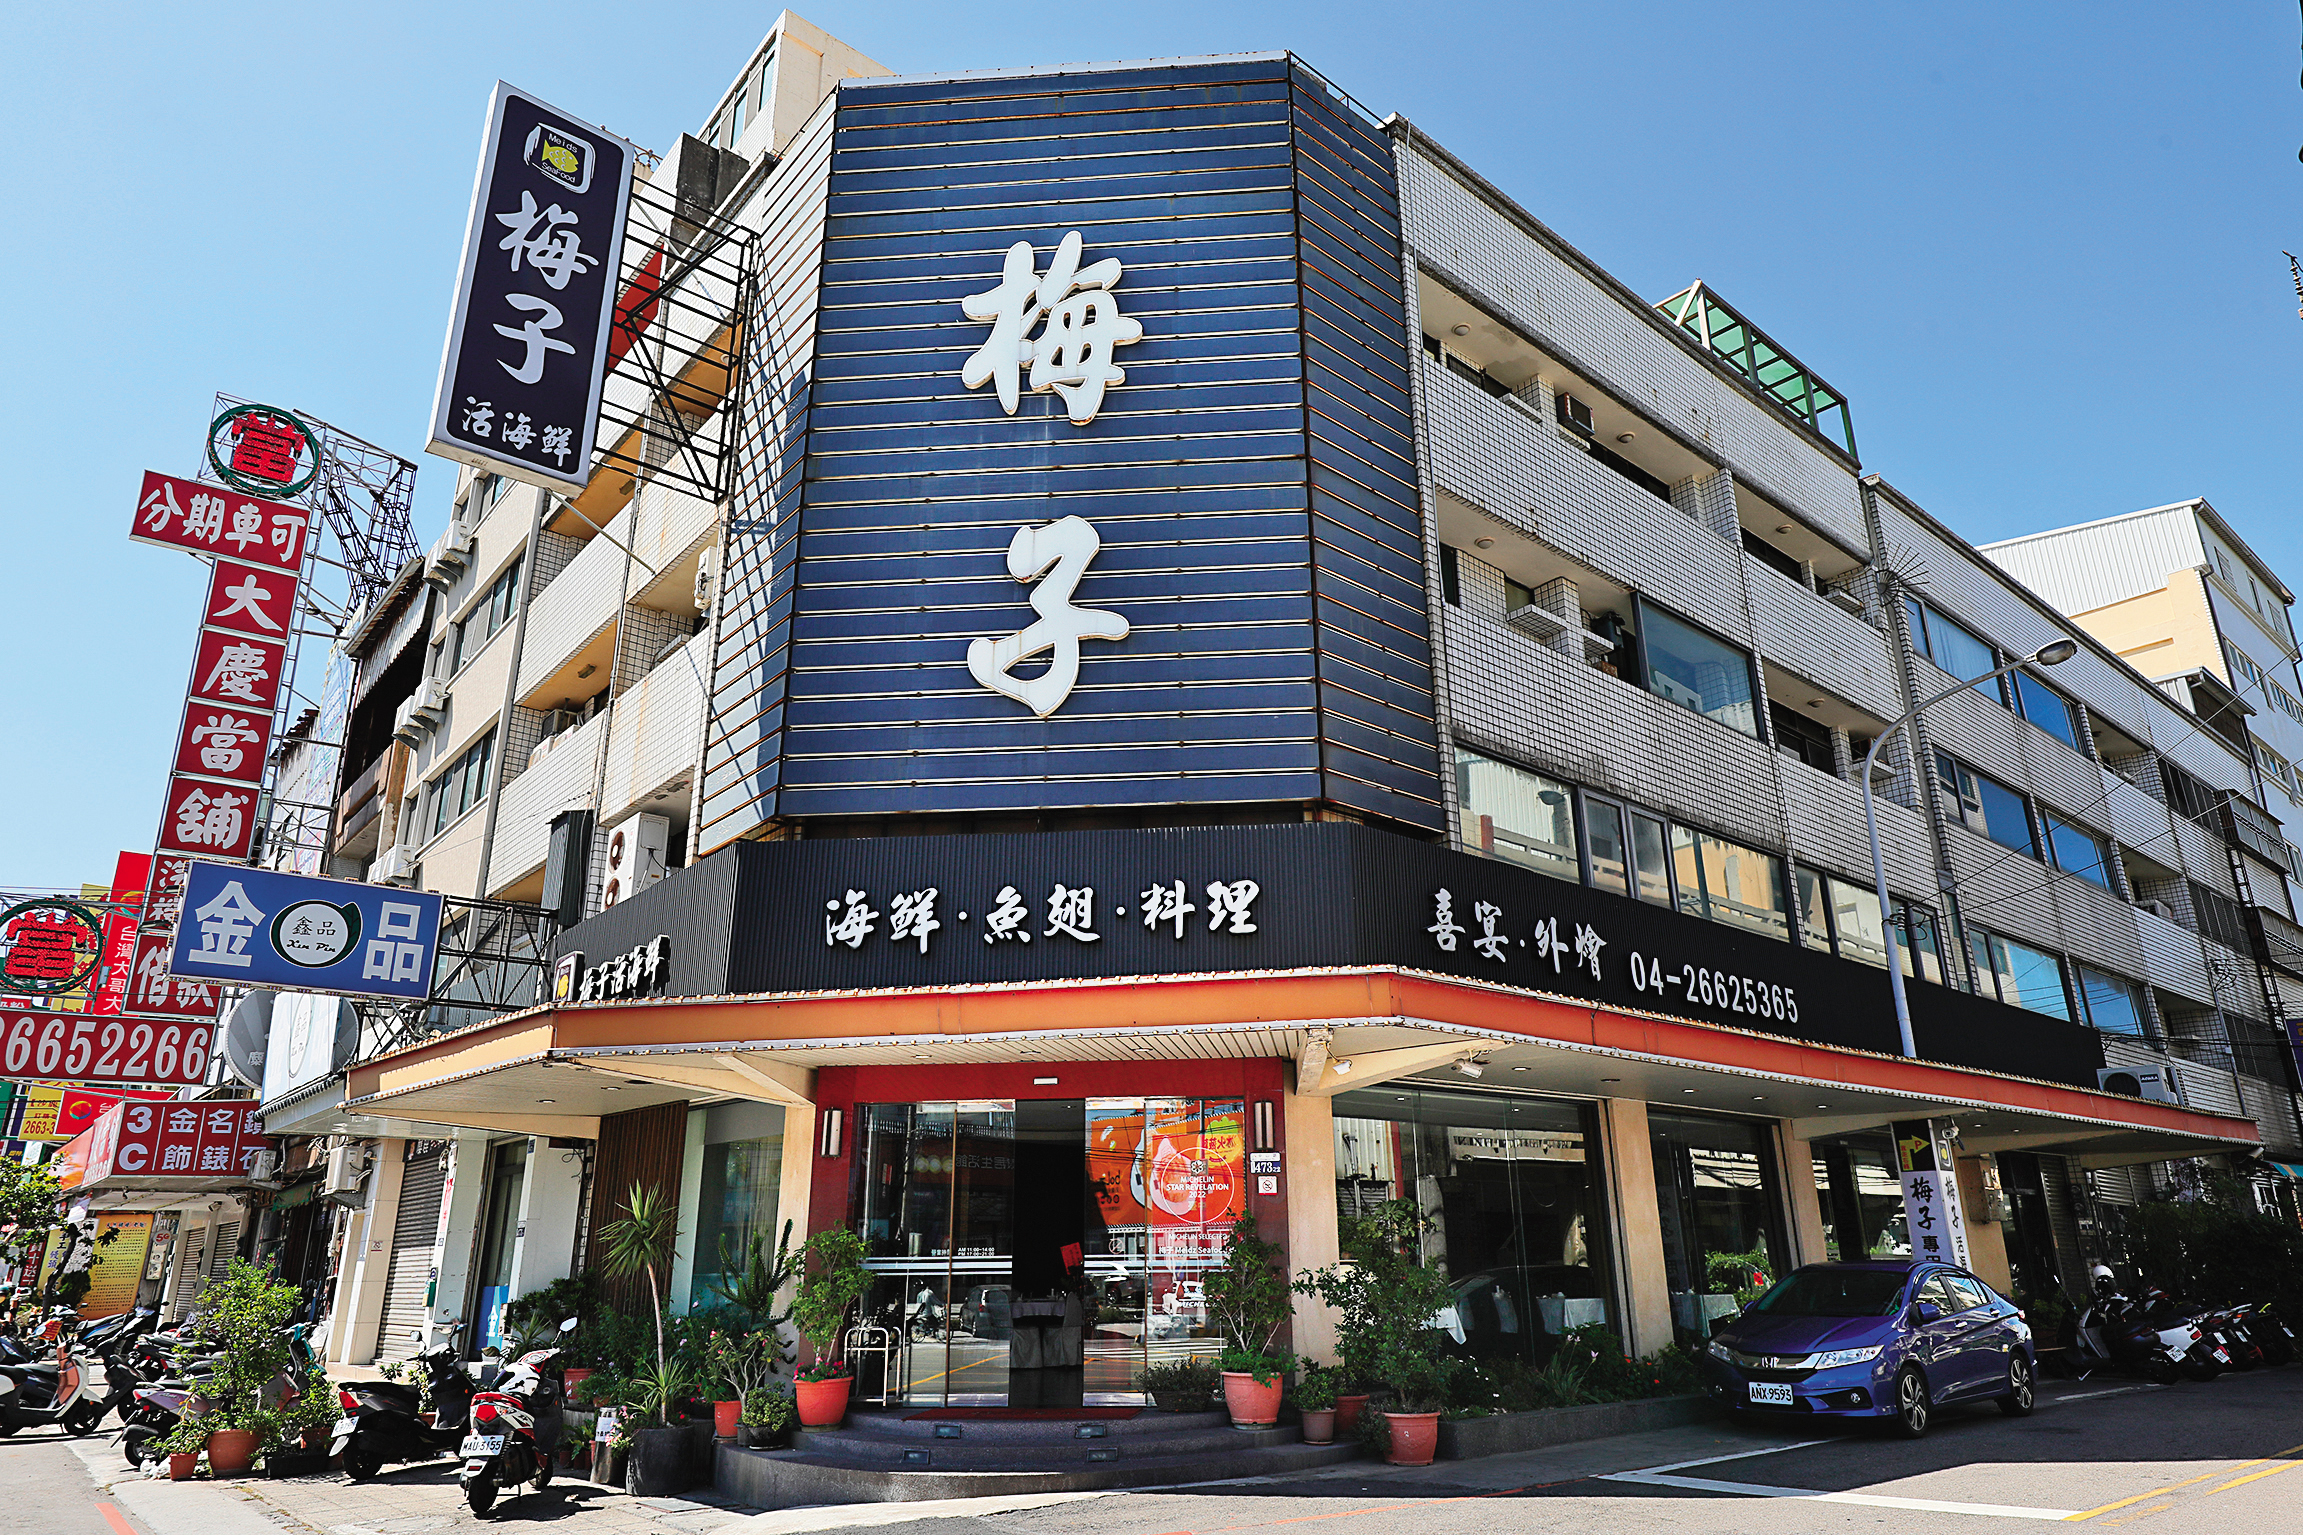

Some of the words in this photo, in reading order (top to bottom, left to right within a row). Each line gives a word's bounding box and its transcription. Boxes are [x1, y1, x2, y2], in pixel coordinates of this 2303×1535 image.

[492, 190, 599, 385] 梅子
[462, 395, 573, 467] 活海鮮
[962, 230, 1144, 718] 梅子
[292, 915, 337, 937] 鑫品
[1630, 951, 1800, 1024] 04-26625365
[0, 1016, 209, 1080] 6652266
[118, 1106, 152, 1171] 3C
[161, 1107, 198, 1171] 金飾
[200, 1108, 235, 1171] 名錶
[1915, 1140, 1922, 1150] P
[1180, 1175, 1215, 1183] MICHELIN
[155, 1232, 170, 1243] 5G
[1751, 1386, 1792, 1402] ANX-9593
